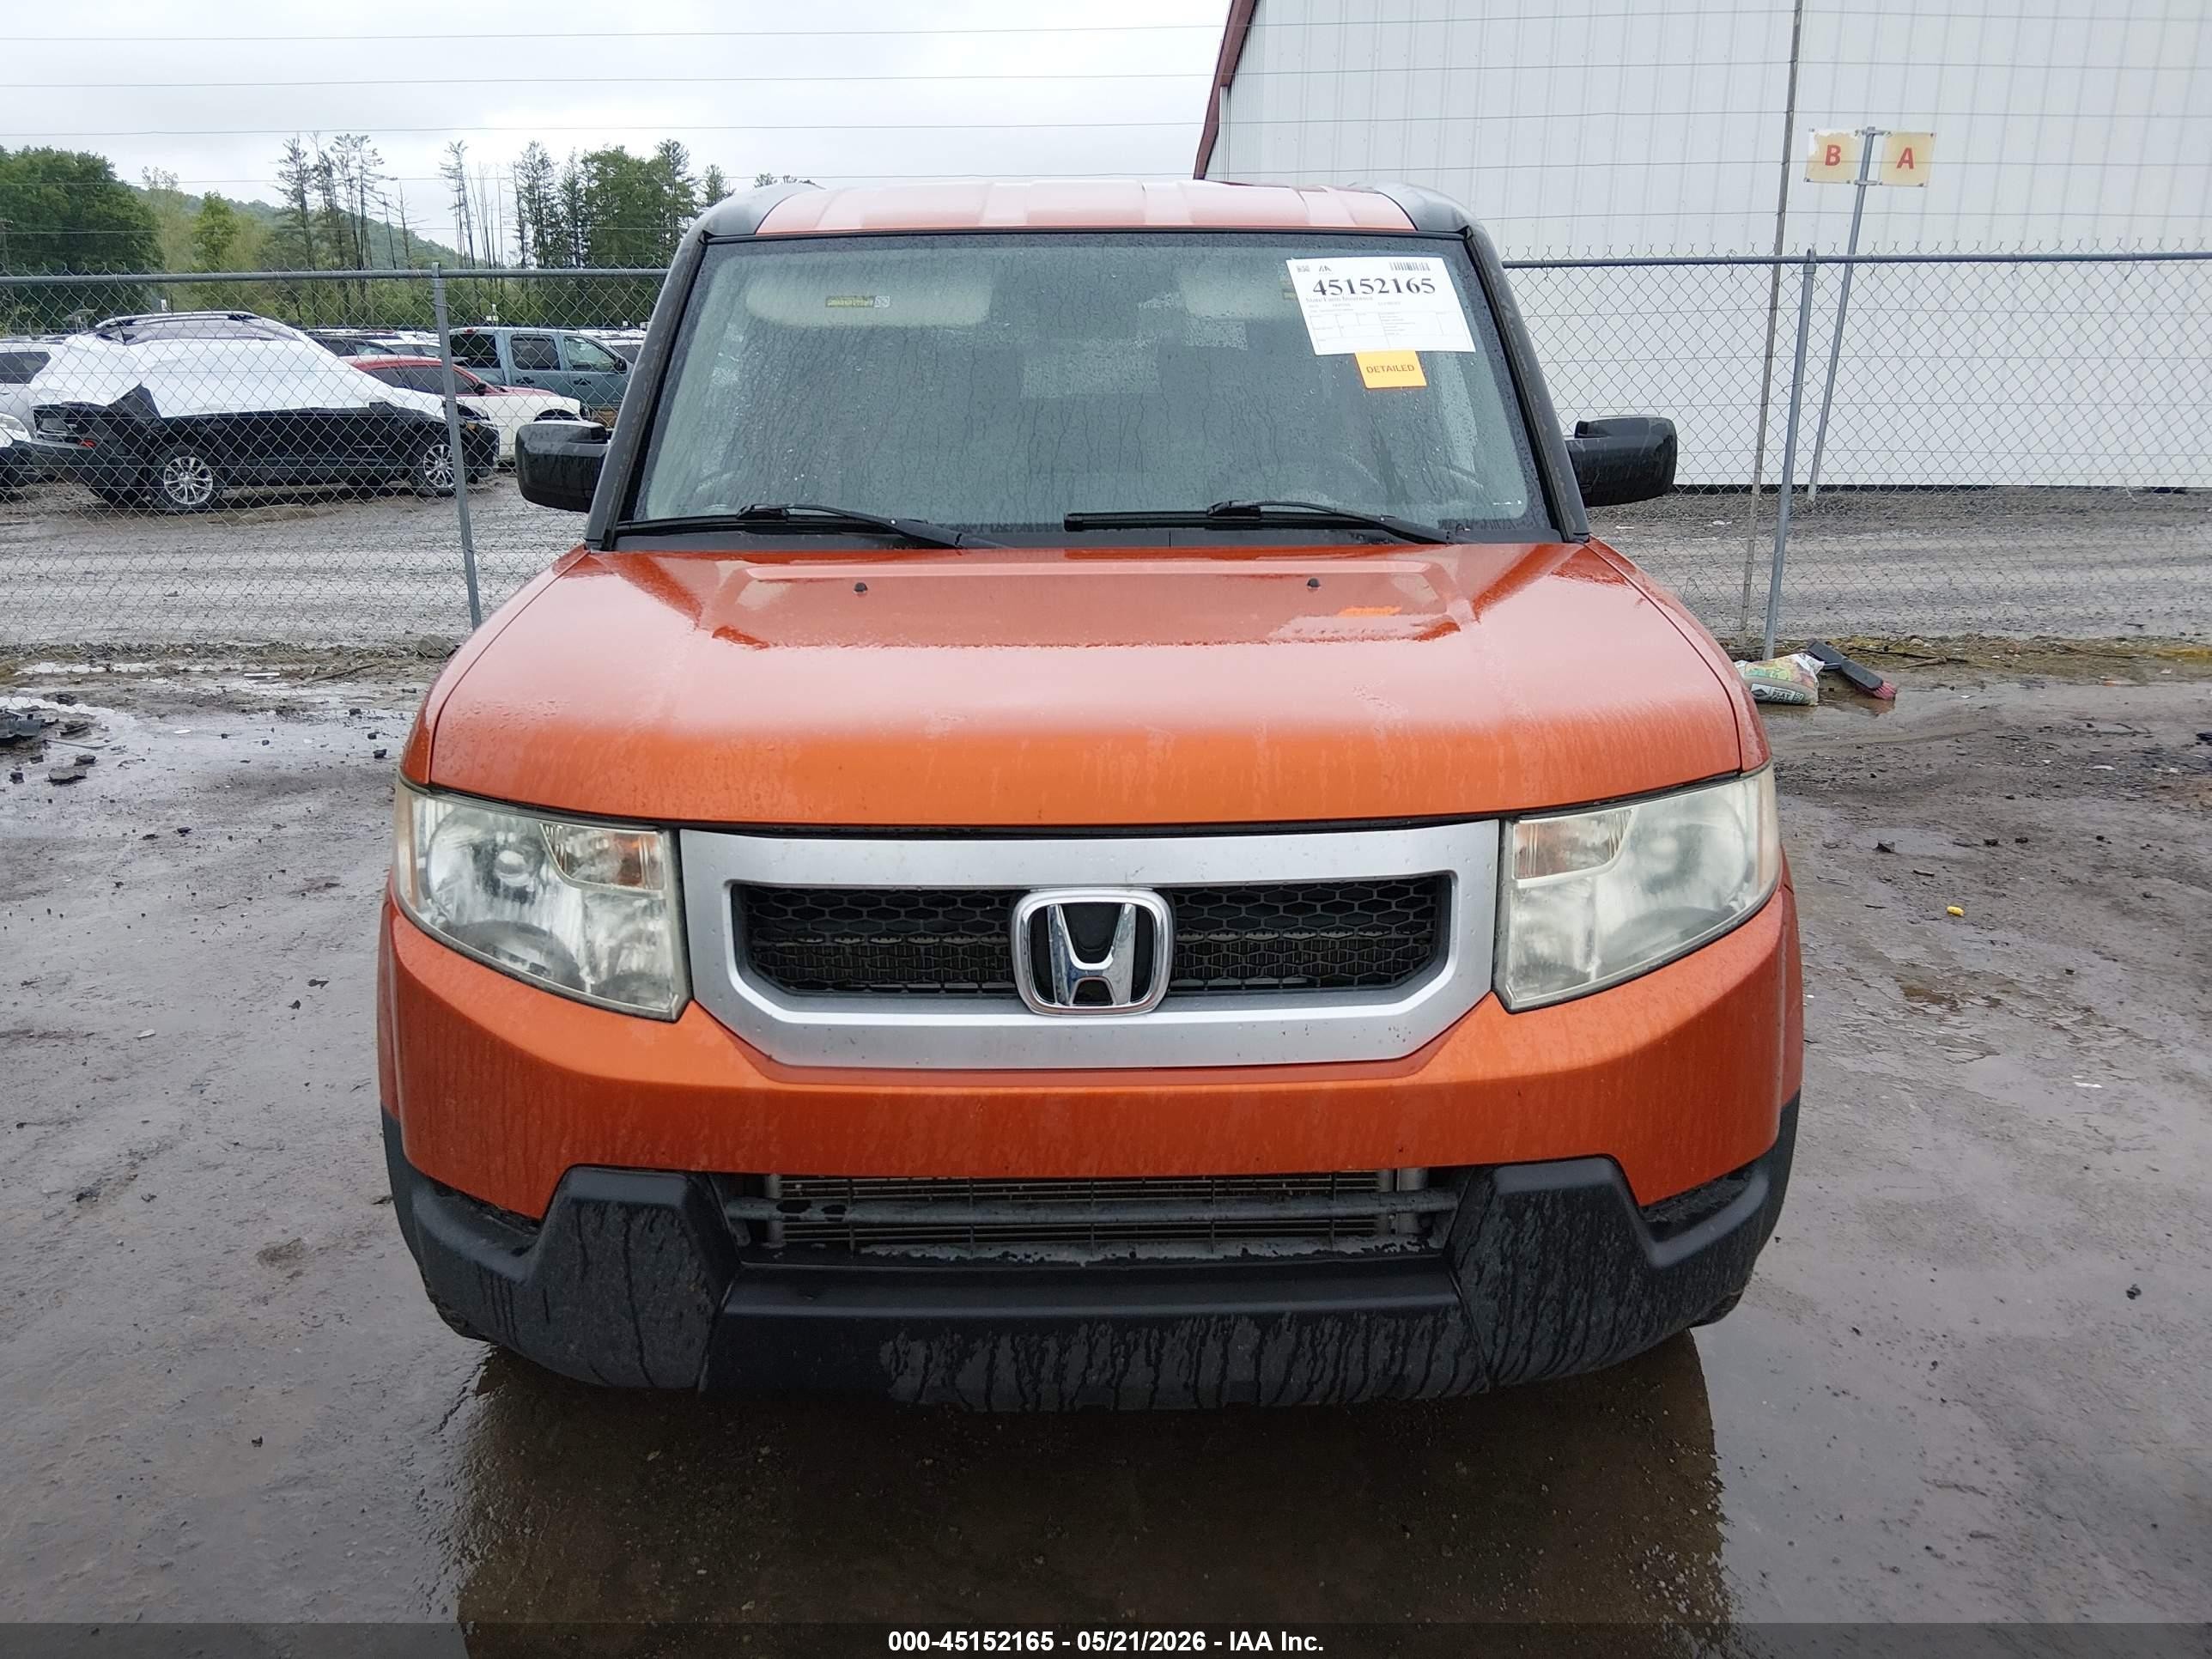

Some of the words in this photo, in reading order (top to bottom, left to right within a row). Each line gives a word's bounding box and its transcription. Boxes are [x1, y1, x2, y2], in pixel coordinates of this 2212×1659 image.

[1824, 144, 1841, 166] B
[1896, 147, 1915, 169] A
[1312, 277, 1436, 296] 45152165
[1366, 363, 1415, 374] DETAILED
